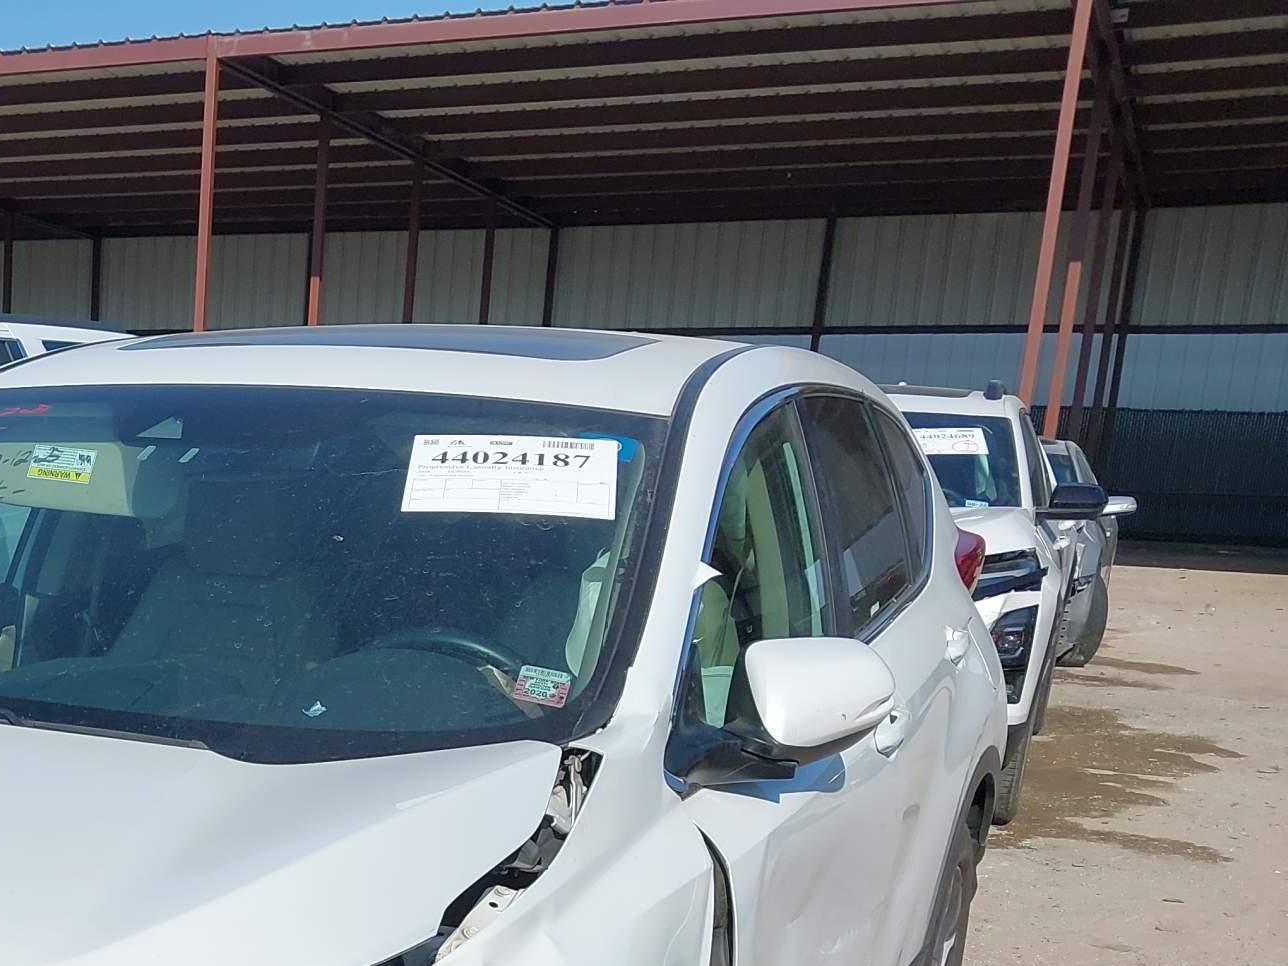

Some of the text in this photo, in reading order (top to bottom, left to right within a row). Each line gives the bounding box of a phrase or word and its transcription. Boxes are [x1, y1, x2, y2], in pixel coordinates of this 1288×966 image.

[431, 450, 591, 469] 44024187
[37, 467, 71, 480] WARNING
[523, 687, 548, 698] 2020
